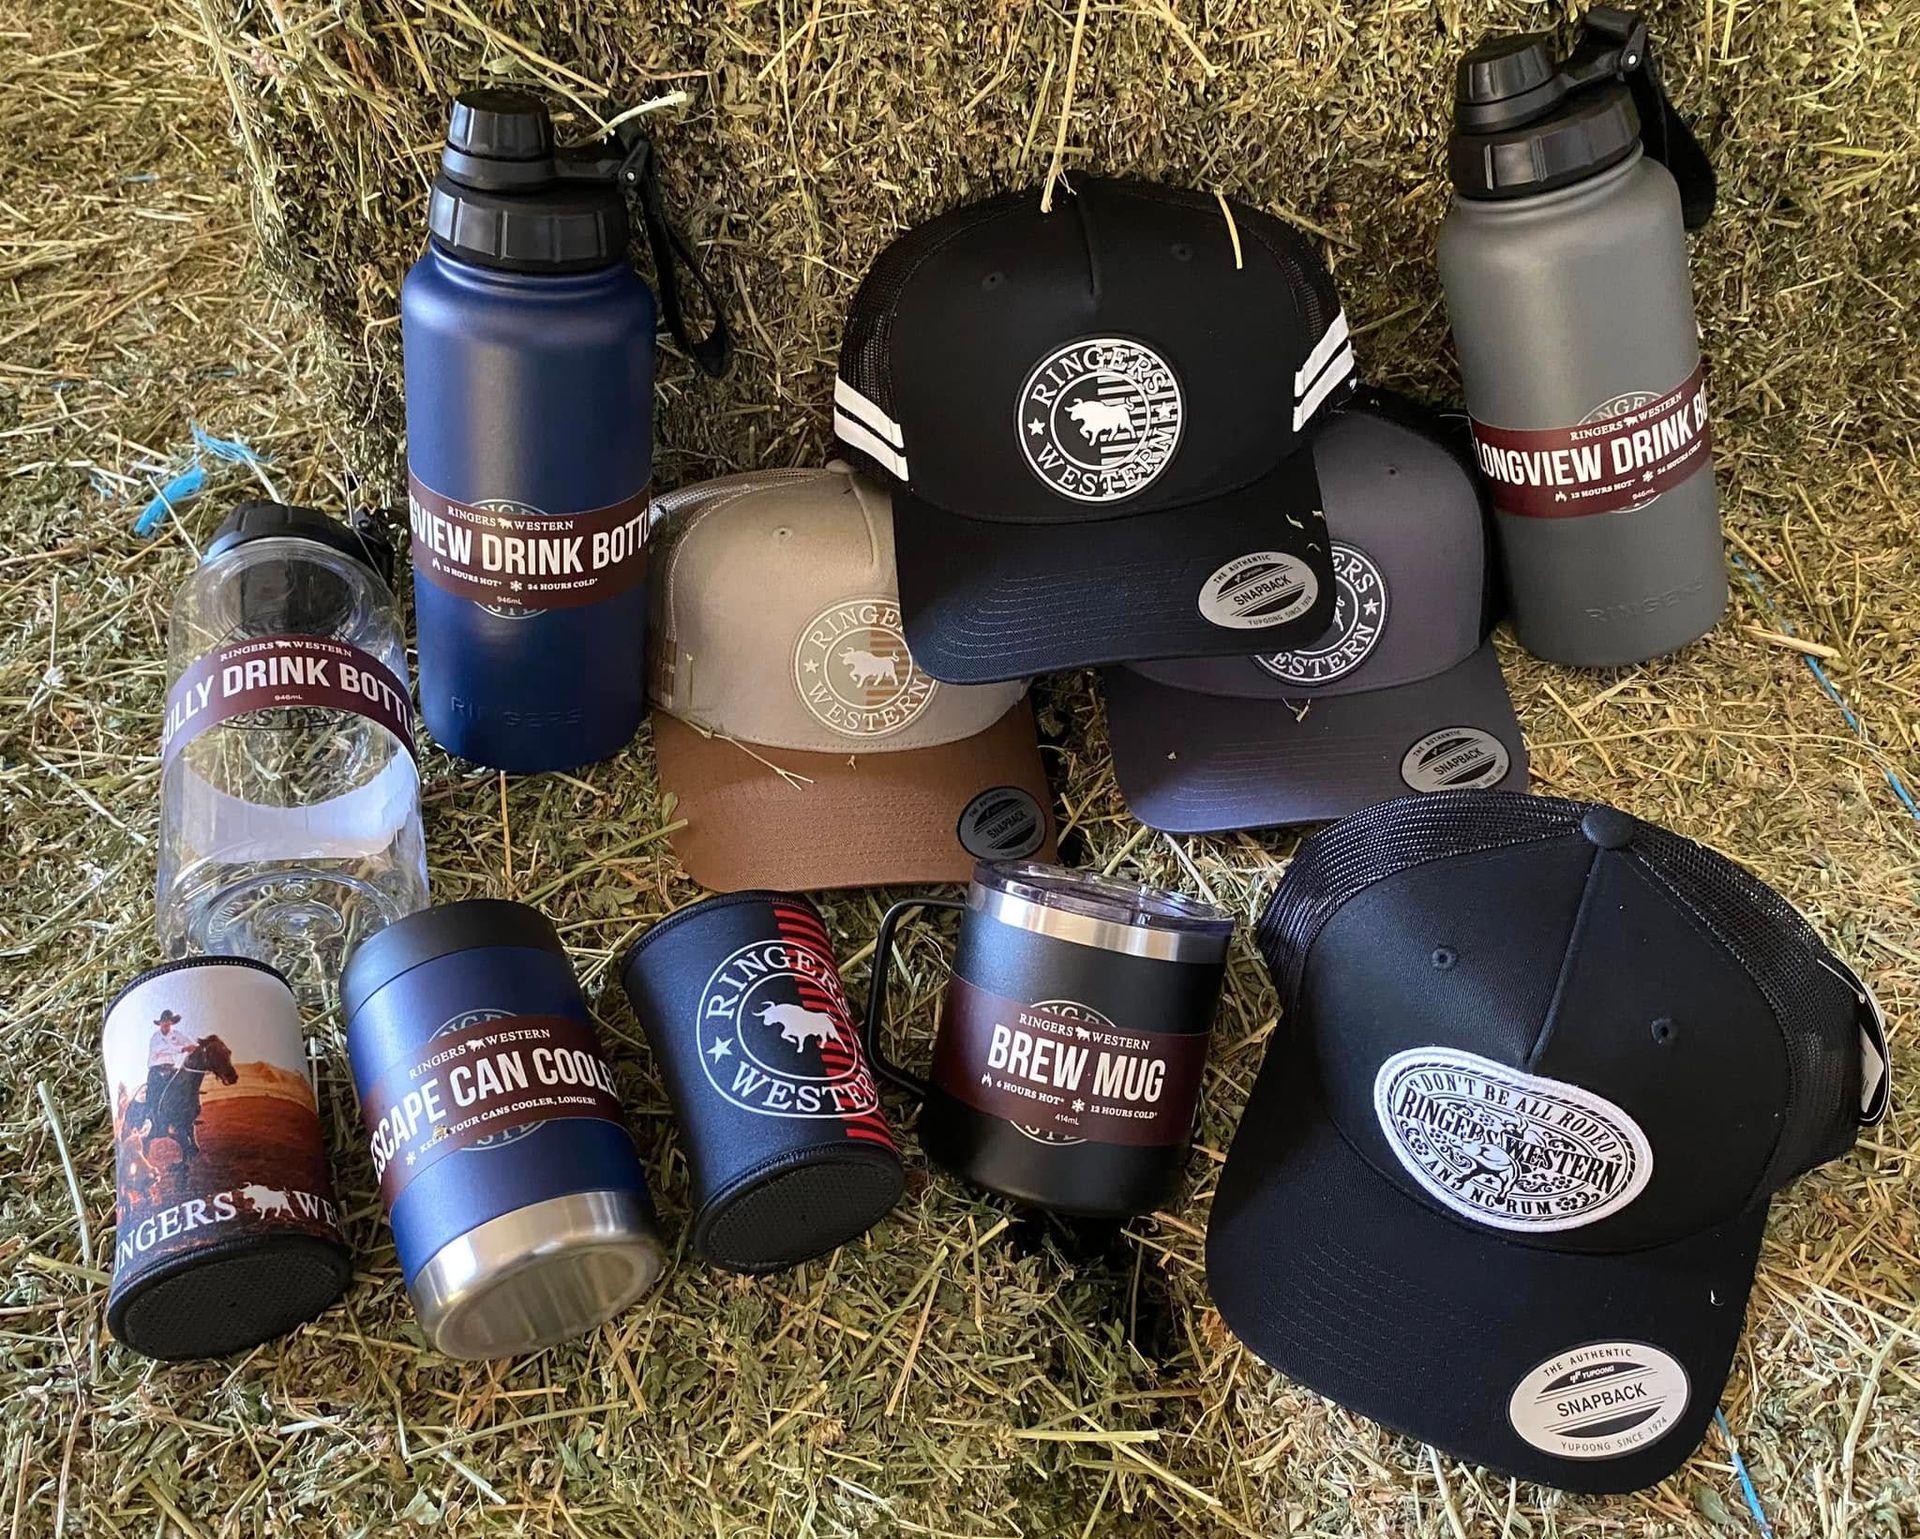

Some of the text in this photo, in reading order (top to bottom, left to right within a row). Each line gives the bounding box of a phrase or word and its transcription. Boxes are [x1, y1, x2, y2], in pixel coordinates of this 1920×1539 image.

[1031, 346, 1168, 408] RINGERS
[1570, 391, 1682, 441] RINGERS WESTERN
[1037, 427, 1173, 495] WESTERN
[1475, 436, 1602, 487] LONGVIEW
[1611, 403, 1693, 475] DRINK
[1581, 485, 1613, 498] HOURS
[447, 505, 497, 528] RINGERS
[514, 520, 574, 532] WESTERN
[481, 533, 584, 575] DRINK
[1213, 572, 1227, 584] THE
[1228, 555, 1271, 572] AUTHENTIC
[451, 568, 479, 583] HOURS
[540, 581, 571, 590] HOURS
[1233, 574, 1293, 605] SNAPBACK
[809, 606, 903, 650] RINGE
[220, 640, 352, 662] RINGERS WESTERN
[1269, 622, 1375, 677] ESTERN
[163, 675, 214, 747] ULLY
[223, 657, 330, 698] DRINK
[808, 678, 929, 731] WESTERN
[1433, 747, 1485, 775] SNAPBACK
[1018, 1013, 1074, 1037] RINGERS
[1092, 1032, 1151, 1050] WESTERN
[408, 1029, 551, 1080] RINGERS WESTERN
[987, 1023, 1166, 1103] BREW MUG
[450, 1050, 529, 1107] CAN
[1003, 1082, 1038, 1100] HOURS
[1090, 1105, 1101, 1113] 12
[1101, 1108, 1133, 1119] HOURS
[1419, 1072, 1617, 1153] DON'T BE ALL RODEO
[449, 1116, 481, 1135] YOUR
[481, 1105, 510, 1121] CANS
[1055, 1113, 1080, 1126] 414mL
[1505, 1137, 1622, 1194] WESTERN
[292, 1190, 340, 1229] WE
[1506, 1198, 1553, 1215] RUM
[1543, 1348, 1632, 1377] THE AUTHENTIC
[1582, 1365, 1615, 1379] YUPOONG
[1557, 1382, 1648, 1417] SNAPBACK
[1561, 1416, 1668, 1452] YUPOONG SINCE 1974
